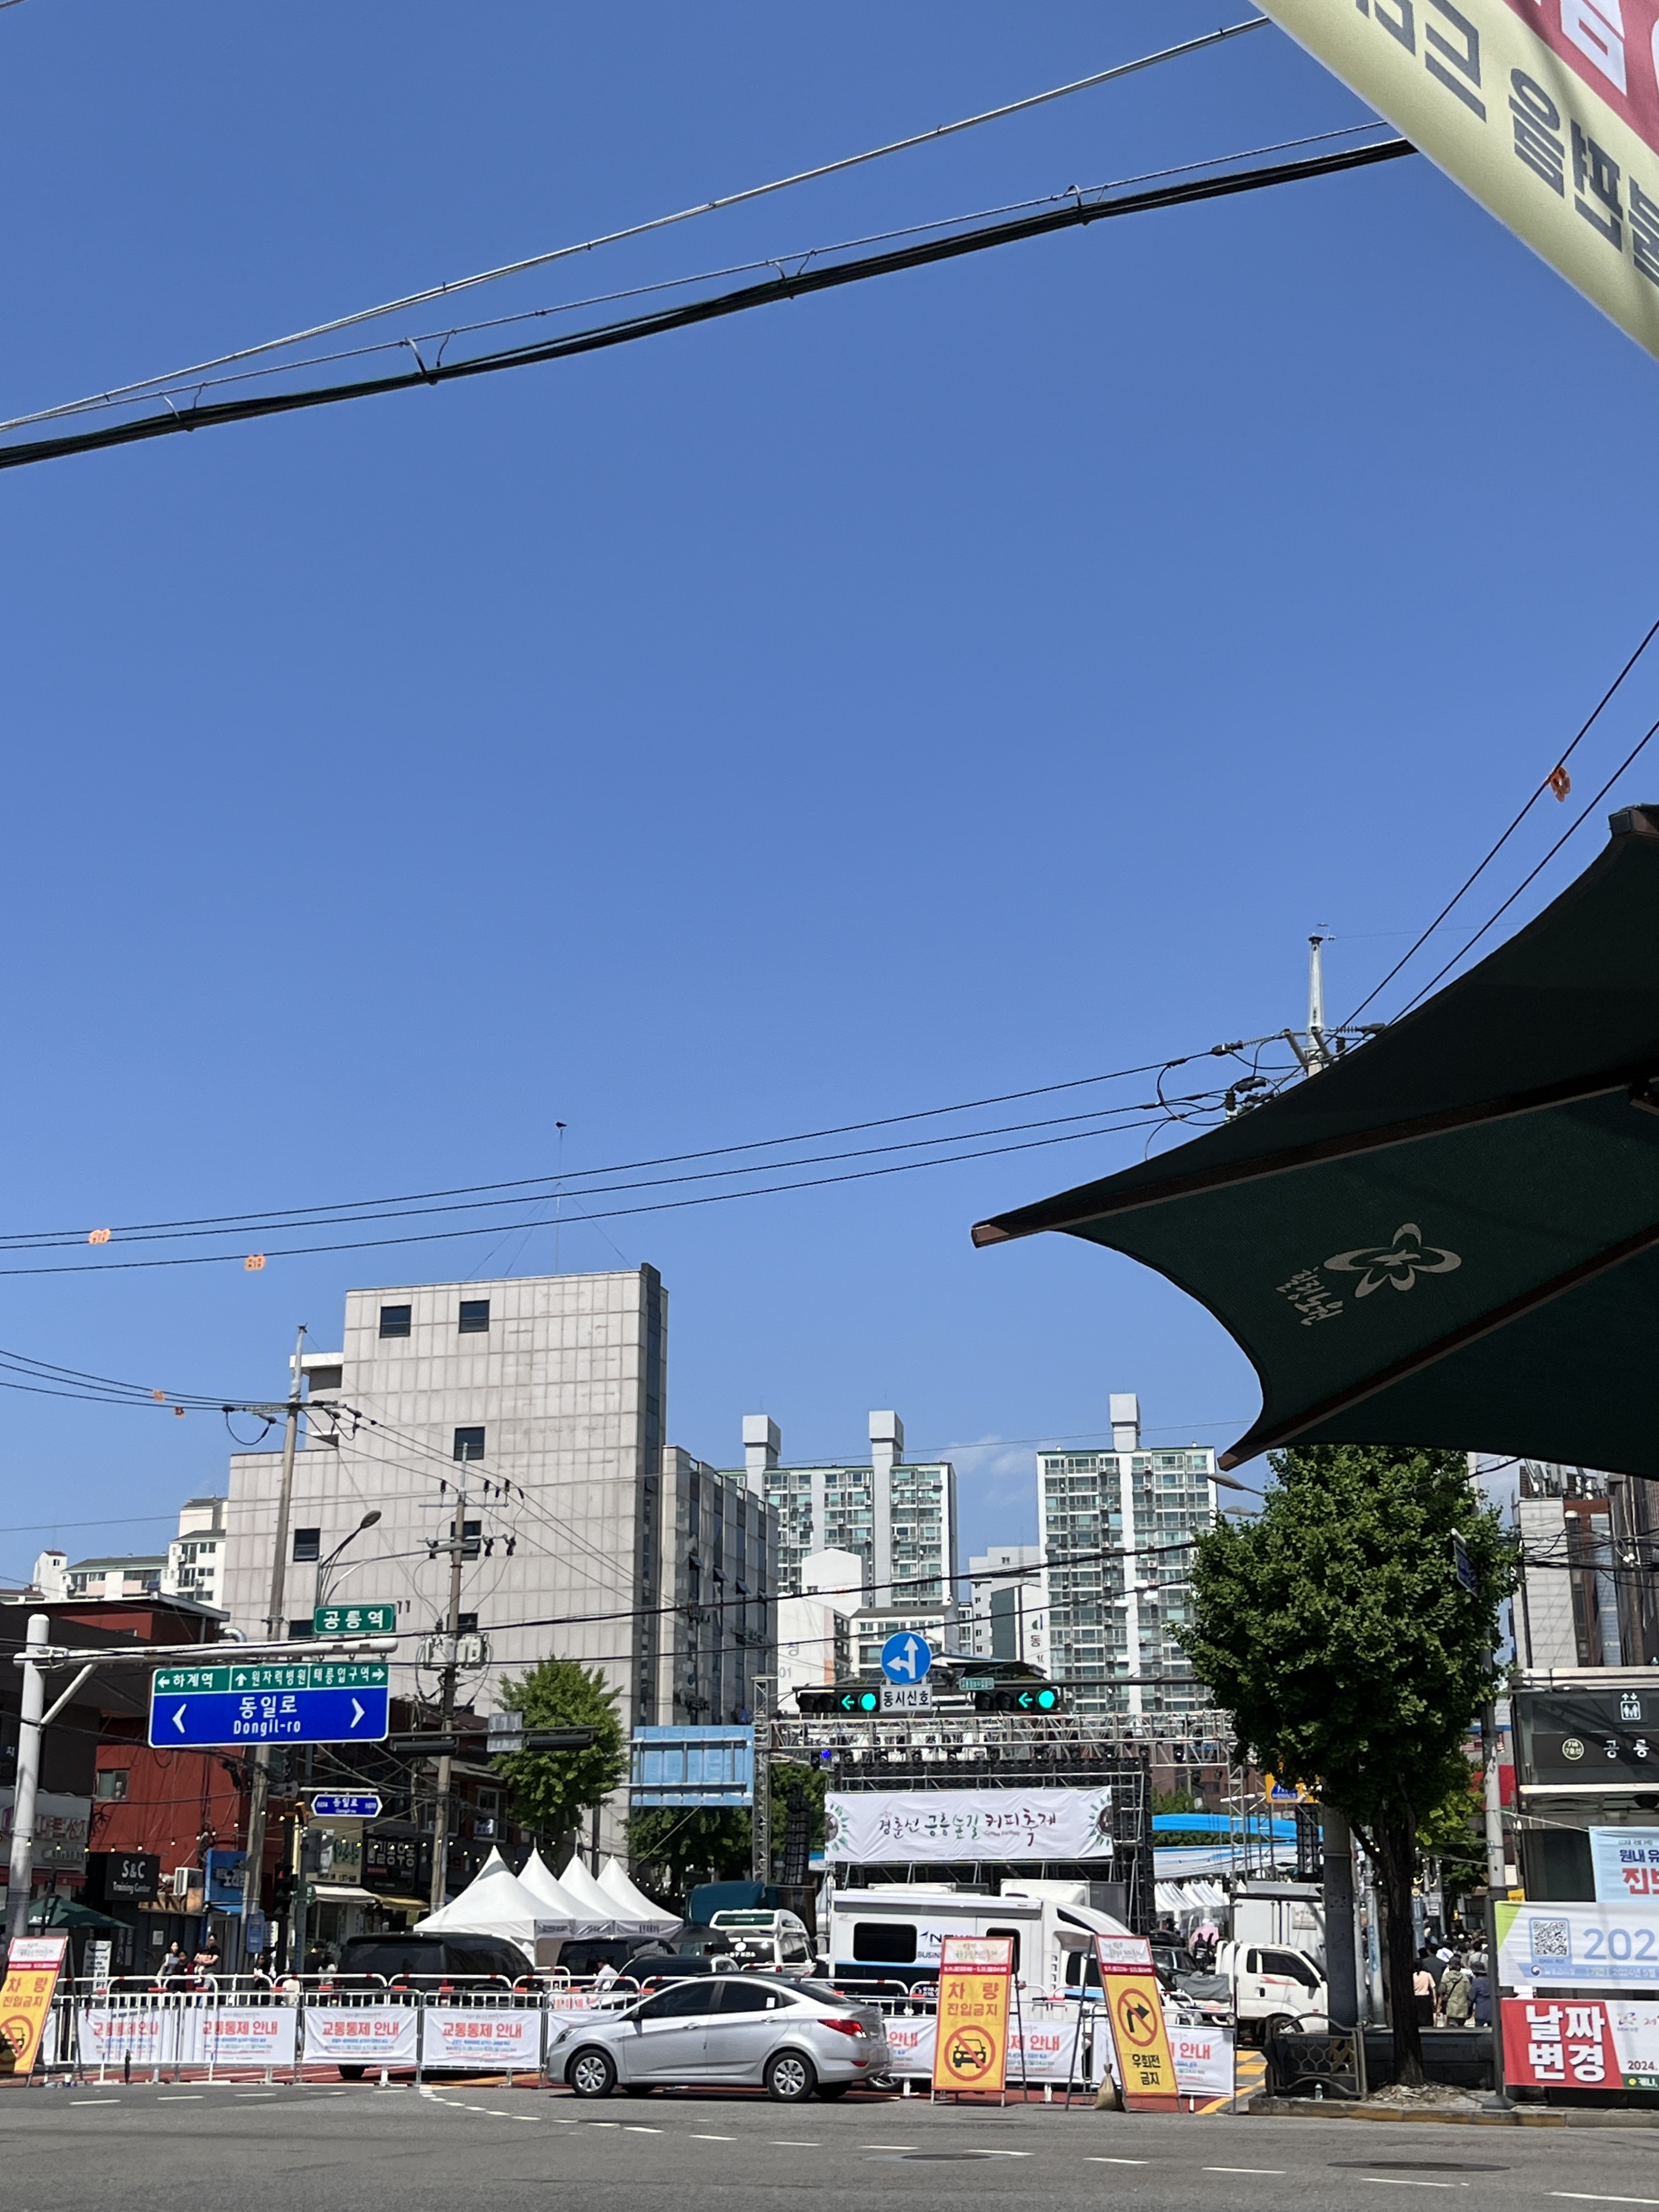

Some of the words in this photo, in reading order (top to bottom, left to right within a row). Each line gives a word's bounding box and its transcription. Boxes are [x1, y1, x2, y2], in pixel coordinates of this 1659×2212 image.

[323, 1609, 384, 1629] 공릉역
[173, 1672, 214, 1688] 하계역
[252, 1669, 306, 1687] 원자력병원
[313, 1666, 370, 1683] 태릉입구역
[239, 1695, 298, 1719] 동일로
[883, 1691, 930, 1707] 동시신호
[233, 1719, 301, 1737] Dongil-ro
[1603, 1739, 1650, 1759] 공릉
[332, 1797, 359, 1808] 동일로
[878, 1817, 919, 1839] 경춘선
[984, 1808, 1056, 1846] 커피축제
[1619, 1849, 1646, 1862] 원내
[122, 1859, 146, 1878] S&C
[1584, 1928, 1659, 1961] 202
[3, 1996, 43, 2008] 진입금지
[946, 2003, 998, 2016] 진입금지
[253, 2021, 278, 2035] 안내
[322, 2021, 370, 2036] 교통통제
[374, 2021, 400, 2036] 안내
[442, 2022, 493, 2037] 교통통제
[497, 2023, 522, 2038] 안내
[1526, 2005, 1605, 2043] 날짜
[889, 2031, 918, 2047] 안내
[1030, 2035, 1060, 2051] 안내
[1180, 2043, 1210, 2059] 안내
[1131, 2054, 1161, 2069] 우회전
[1528, 2043, 1605, 2082] 변경
[1140, 2071, 1160, 2086] 금지
